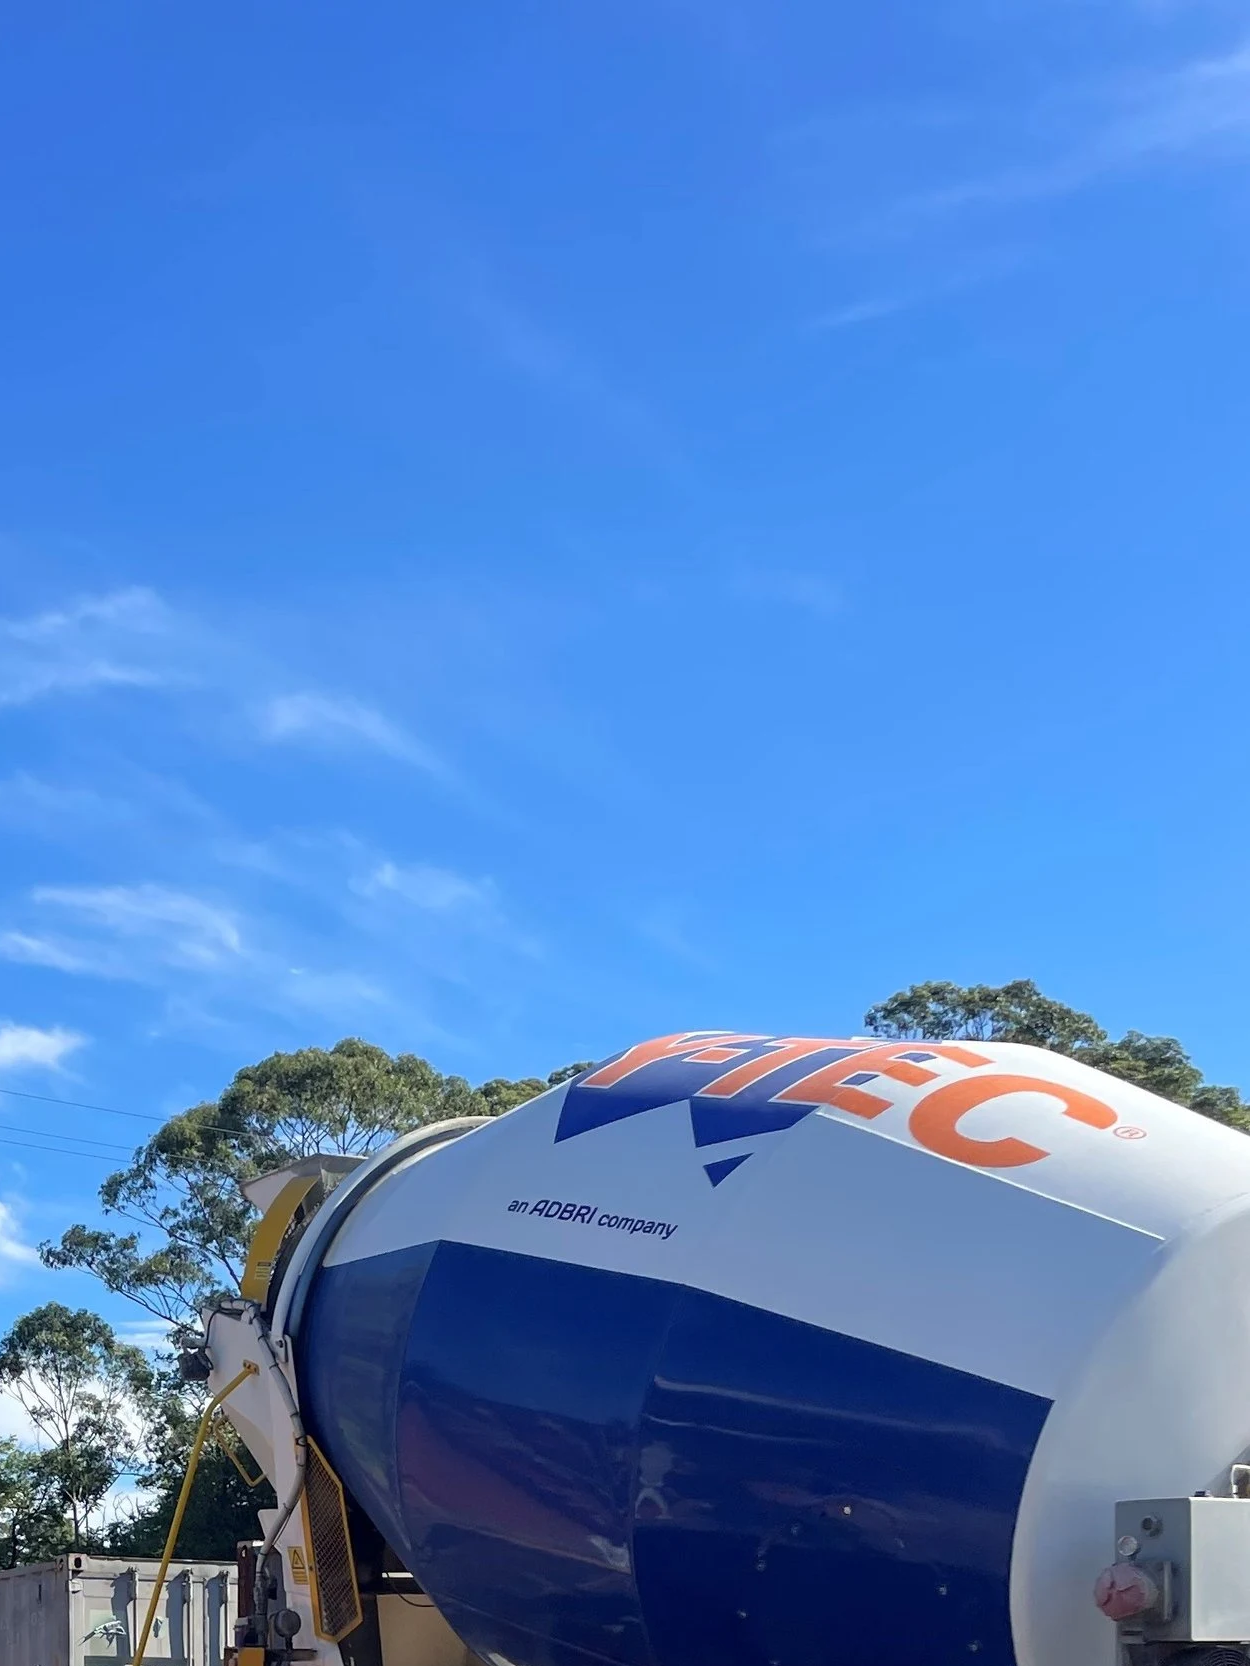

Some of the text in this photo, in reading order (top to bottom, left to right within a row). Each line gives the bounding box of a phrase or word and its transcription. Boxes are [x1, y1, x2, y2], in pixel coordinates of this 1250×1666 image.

[507, 1199, 679, 1240] an ADBRI company
